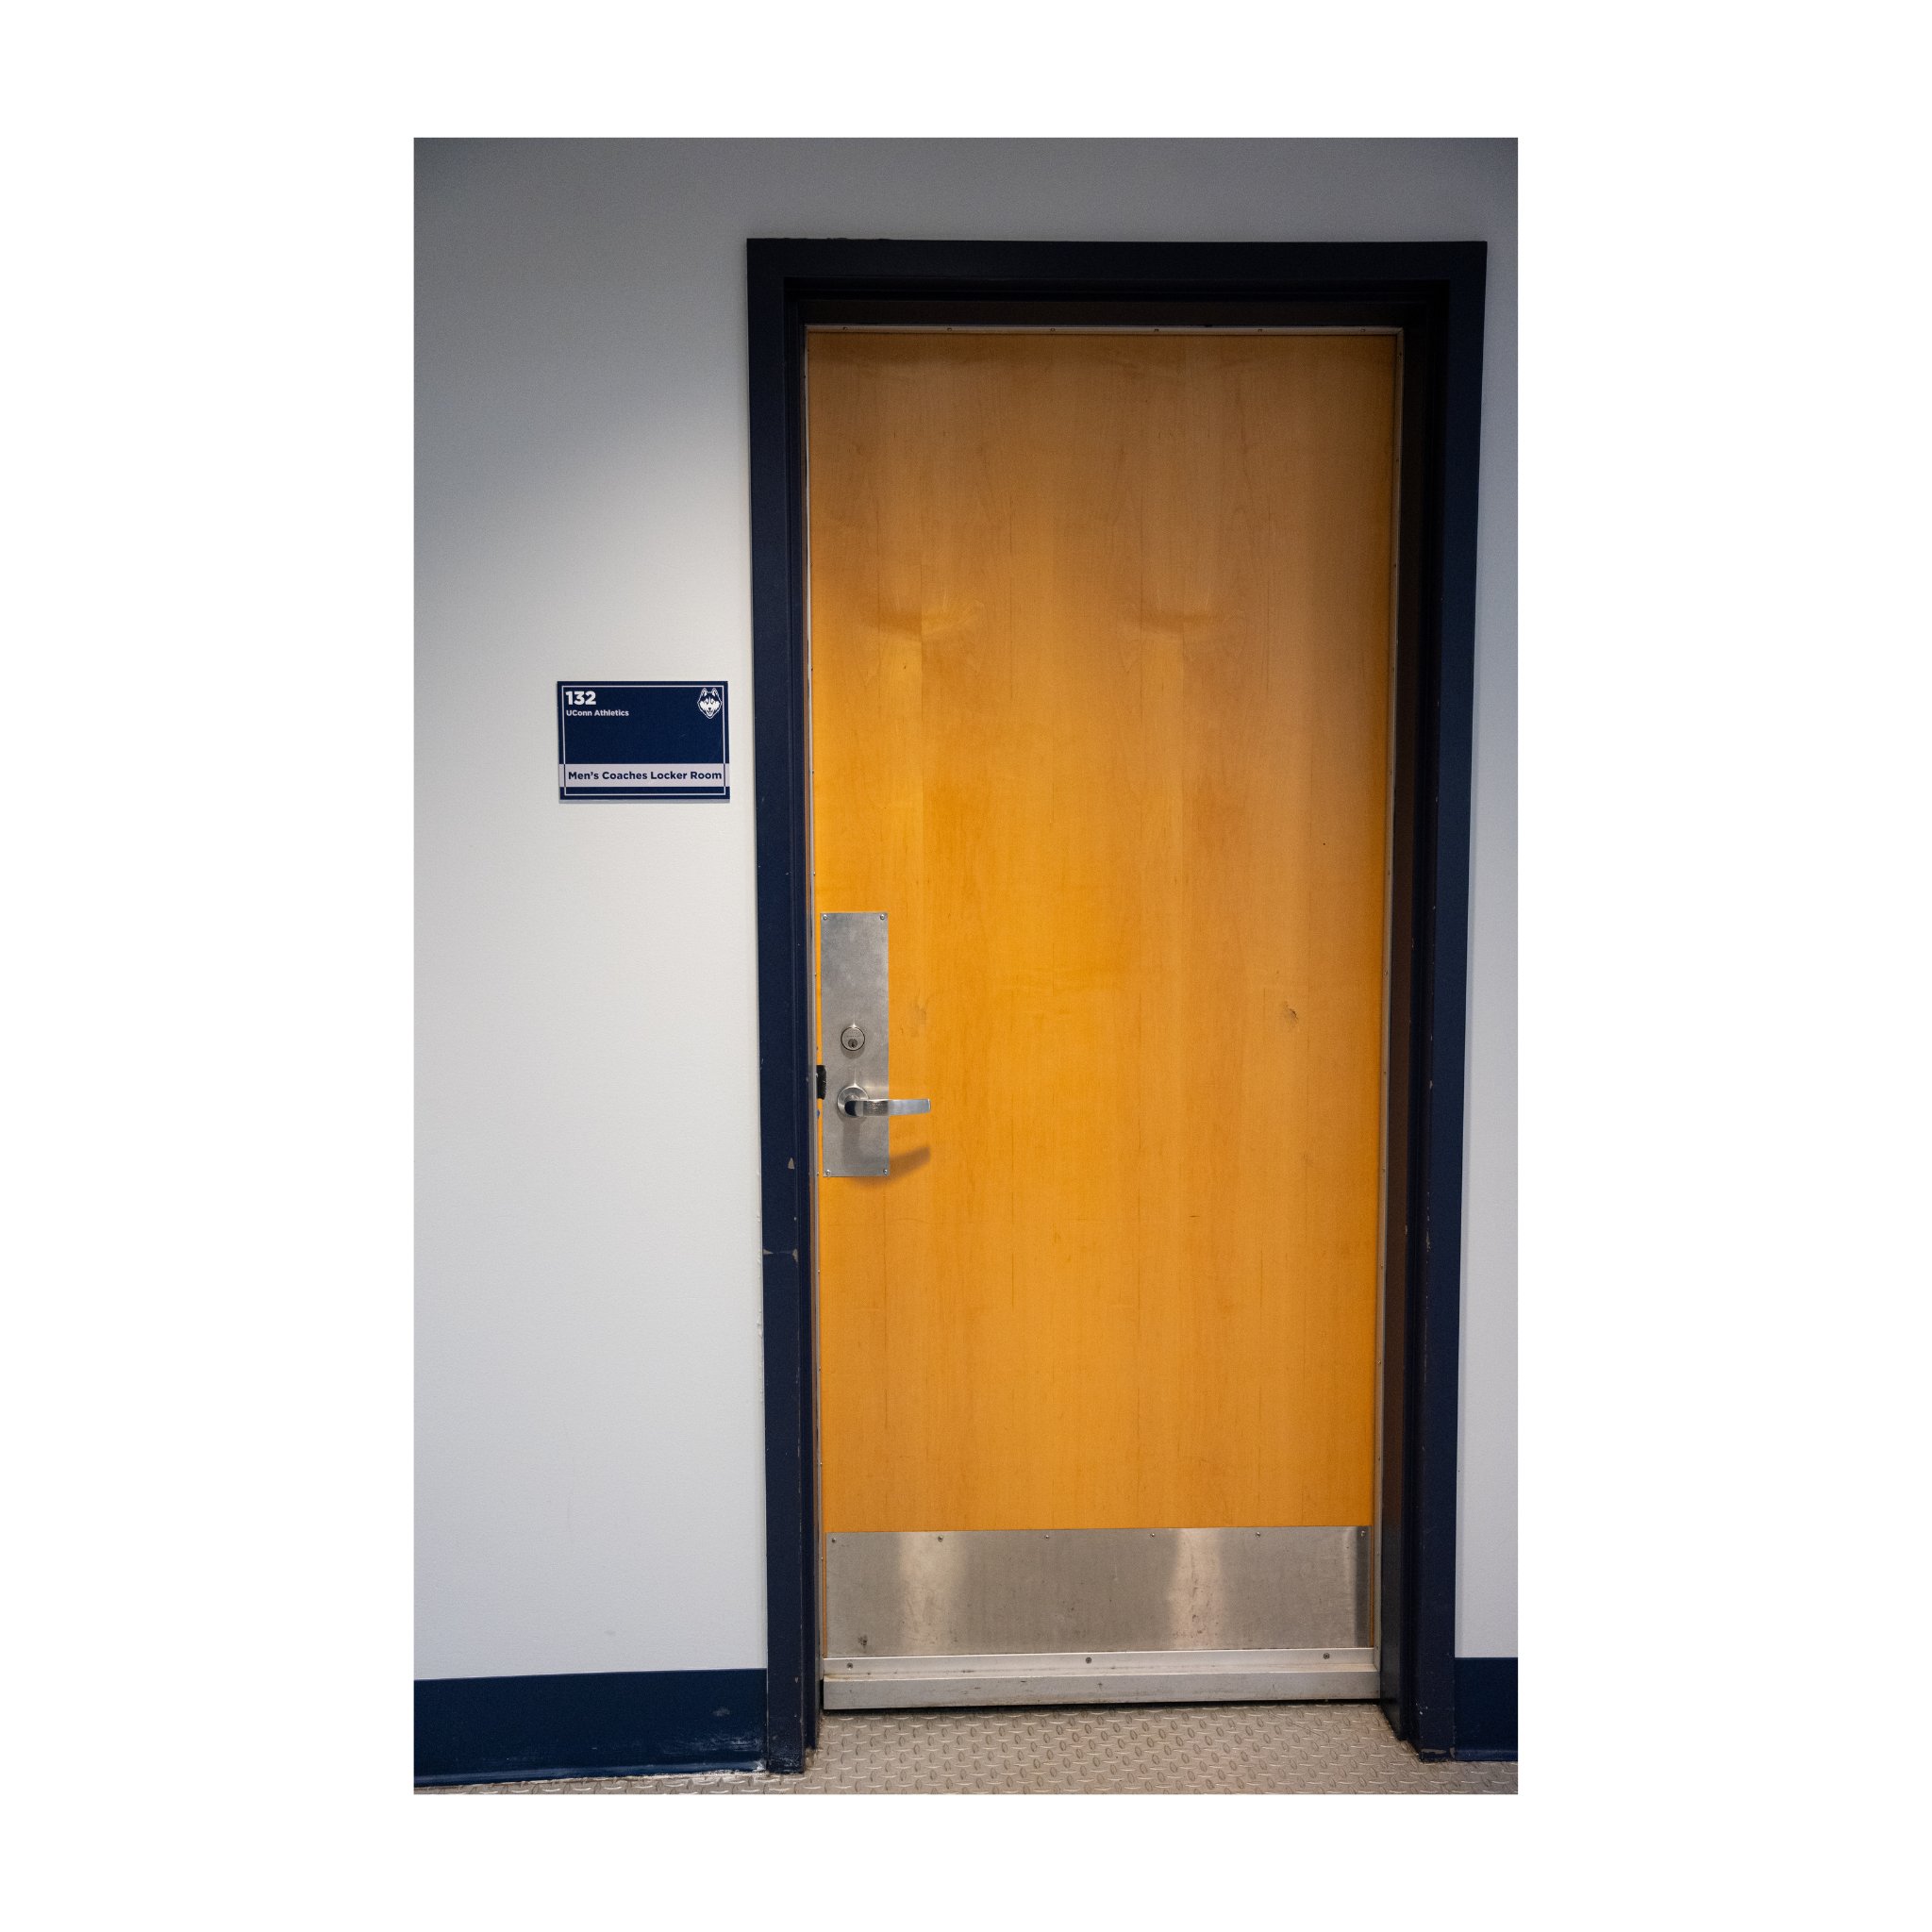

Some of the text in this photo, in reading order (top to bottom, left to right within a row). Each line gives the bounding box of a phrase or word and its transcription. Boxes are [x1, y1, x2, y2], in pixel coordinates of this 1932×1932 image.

[566, 691, 596, 705] 132
[568, 771, 723, 780] Men's Coaches Locker Room
